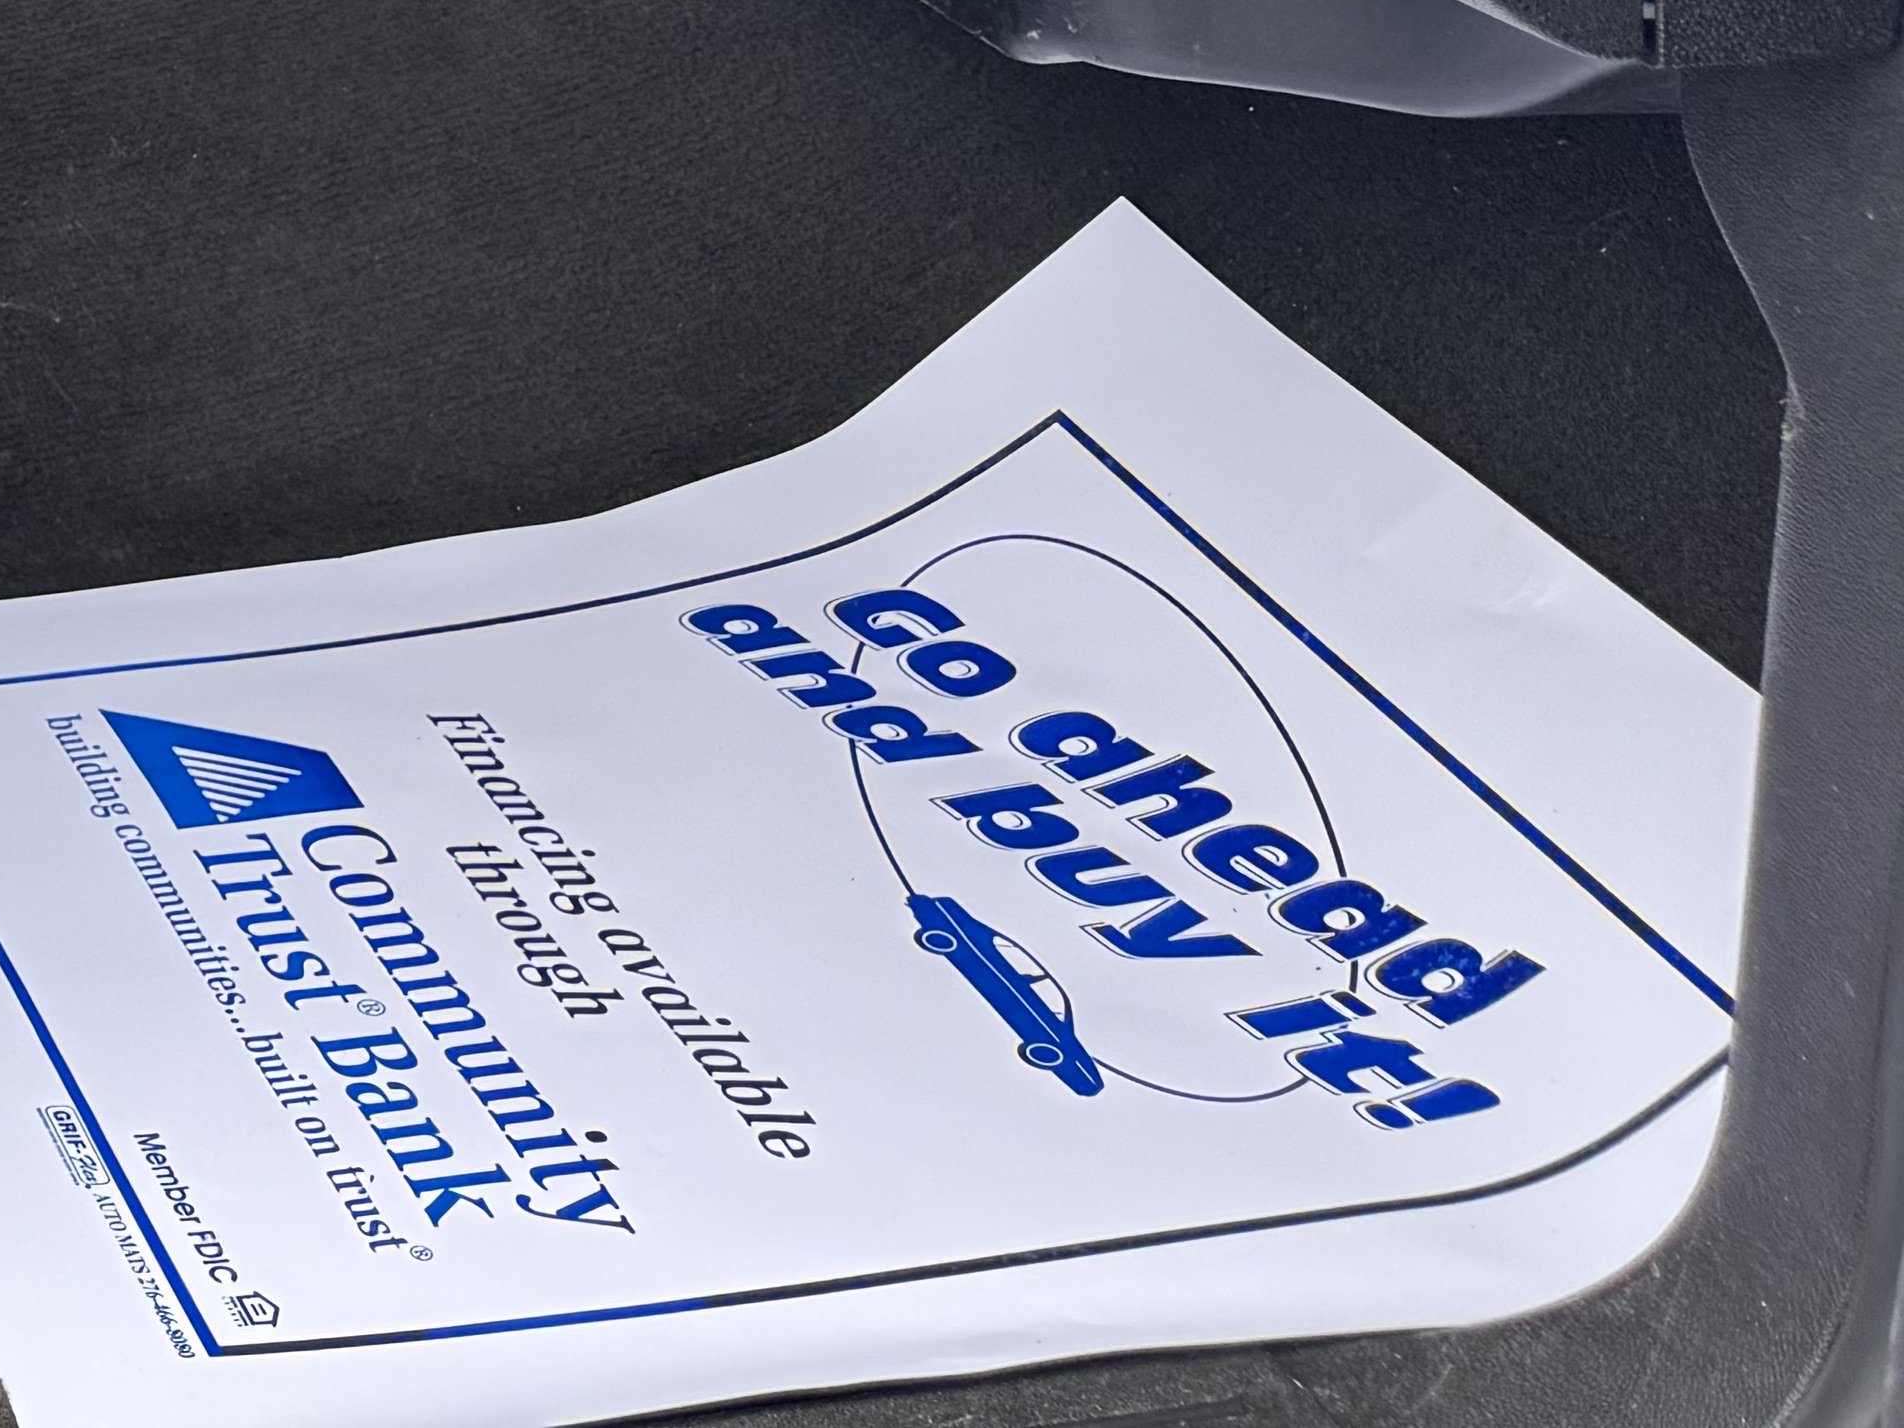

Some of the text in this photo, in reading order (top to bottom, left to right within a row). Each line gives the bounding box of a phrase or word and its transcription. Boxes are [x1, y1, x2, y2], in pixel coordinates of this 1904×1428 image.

[46, 713, 130, 818] building
[294, 1117, 341, 1159] on
[425, 710, 814, 1162] Financing available
[445, 840, 625, 1020] through
[678, 602, 1502, 1132] and buy it!
[823, 588, 1544, 1029] Go ahead
[92, 1192, 128, 1233] AUTO
[115, 1234, 151, 1275] MATS
[133, 1131, 202, 1224] Member
[187, 1229, 239, 1285] FDIC
[300, 823, 637, 1236] Community
[309, 1025, 512, 1229] Bank
